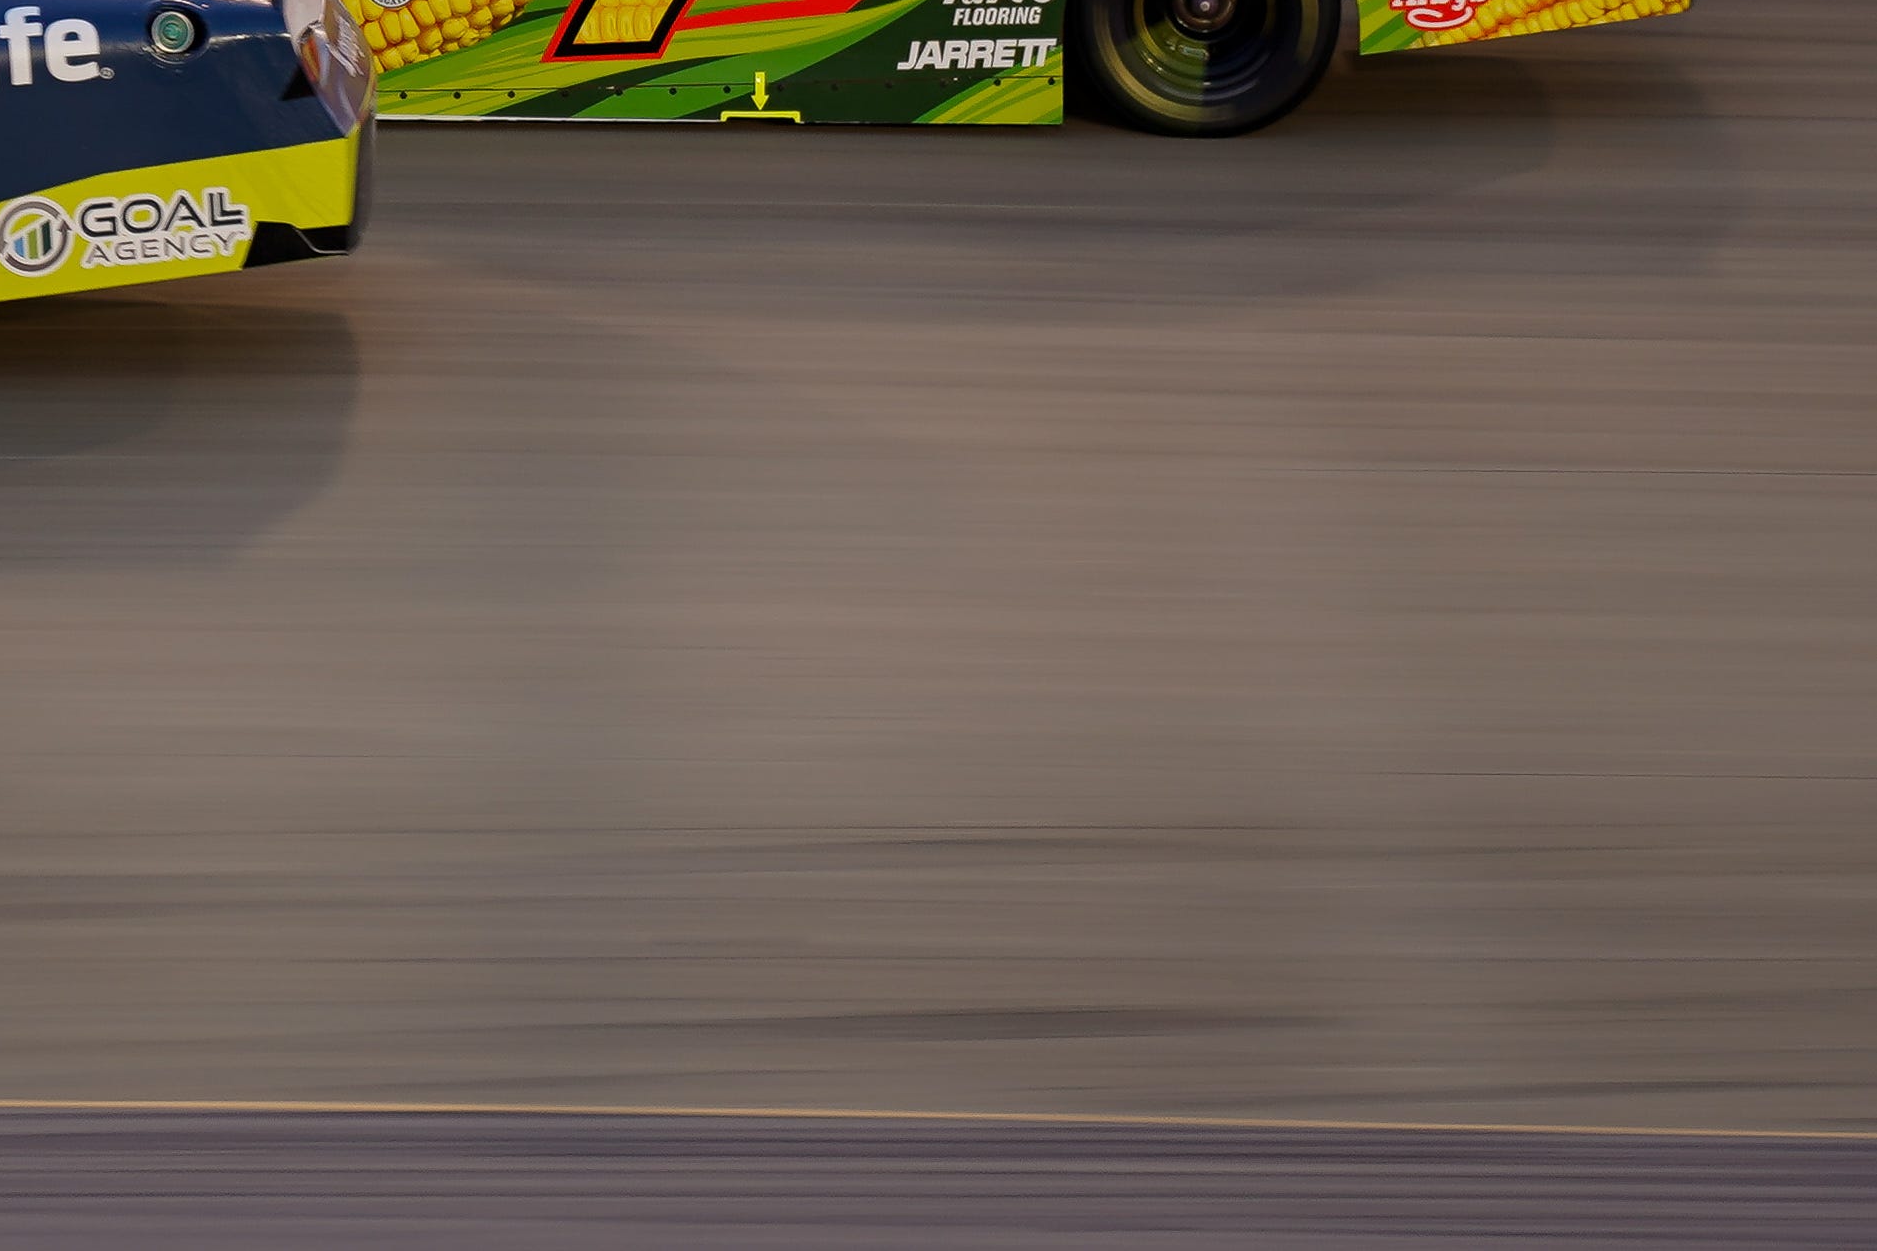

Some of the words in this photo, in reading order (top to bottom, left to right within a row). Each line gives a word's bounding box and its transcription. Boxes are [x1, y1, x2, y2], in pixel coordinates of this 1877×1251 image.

[952, 6, 1042, 26] FLOORING
[896, 38, 1057, 71] JARRETT
[86, 232, 241, 266] AGENCY
